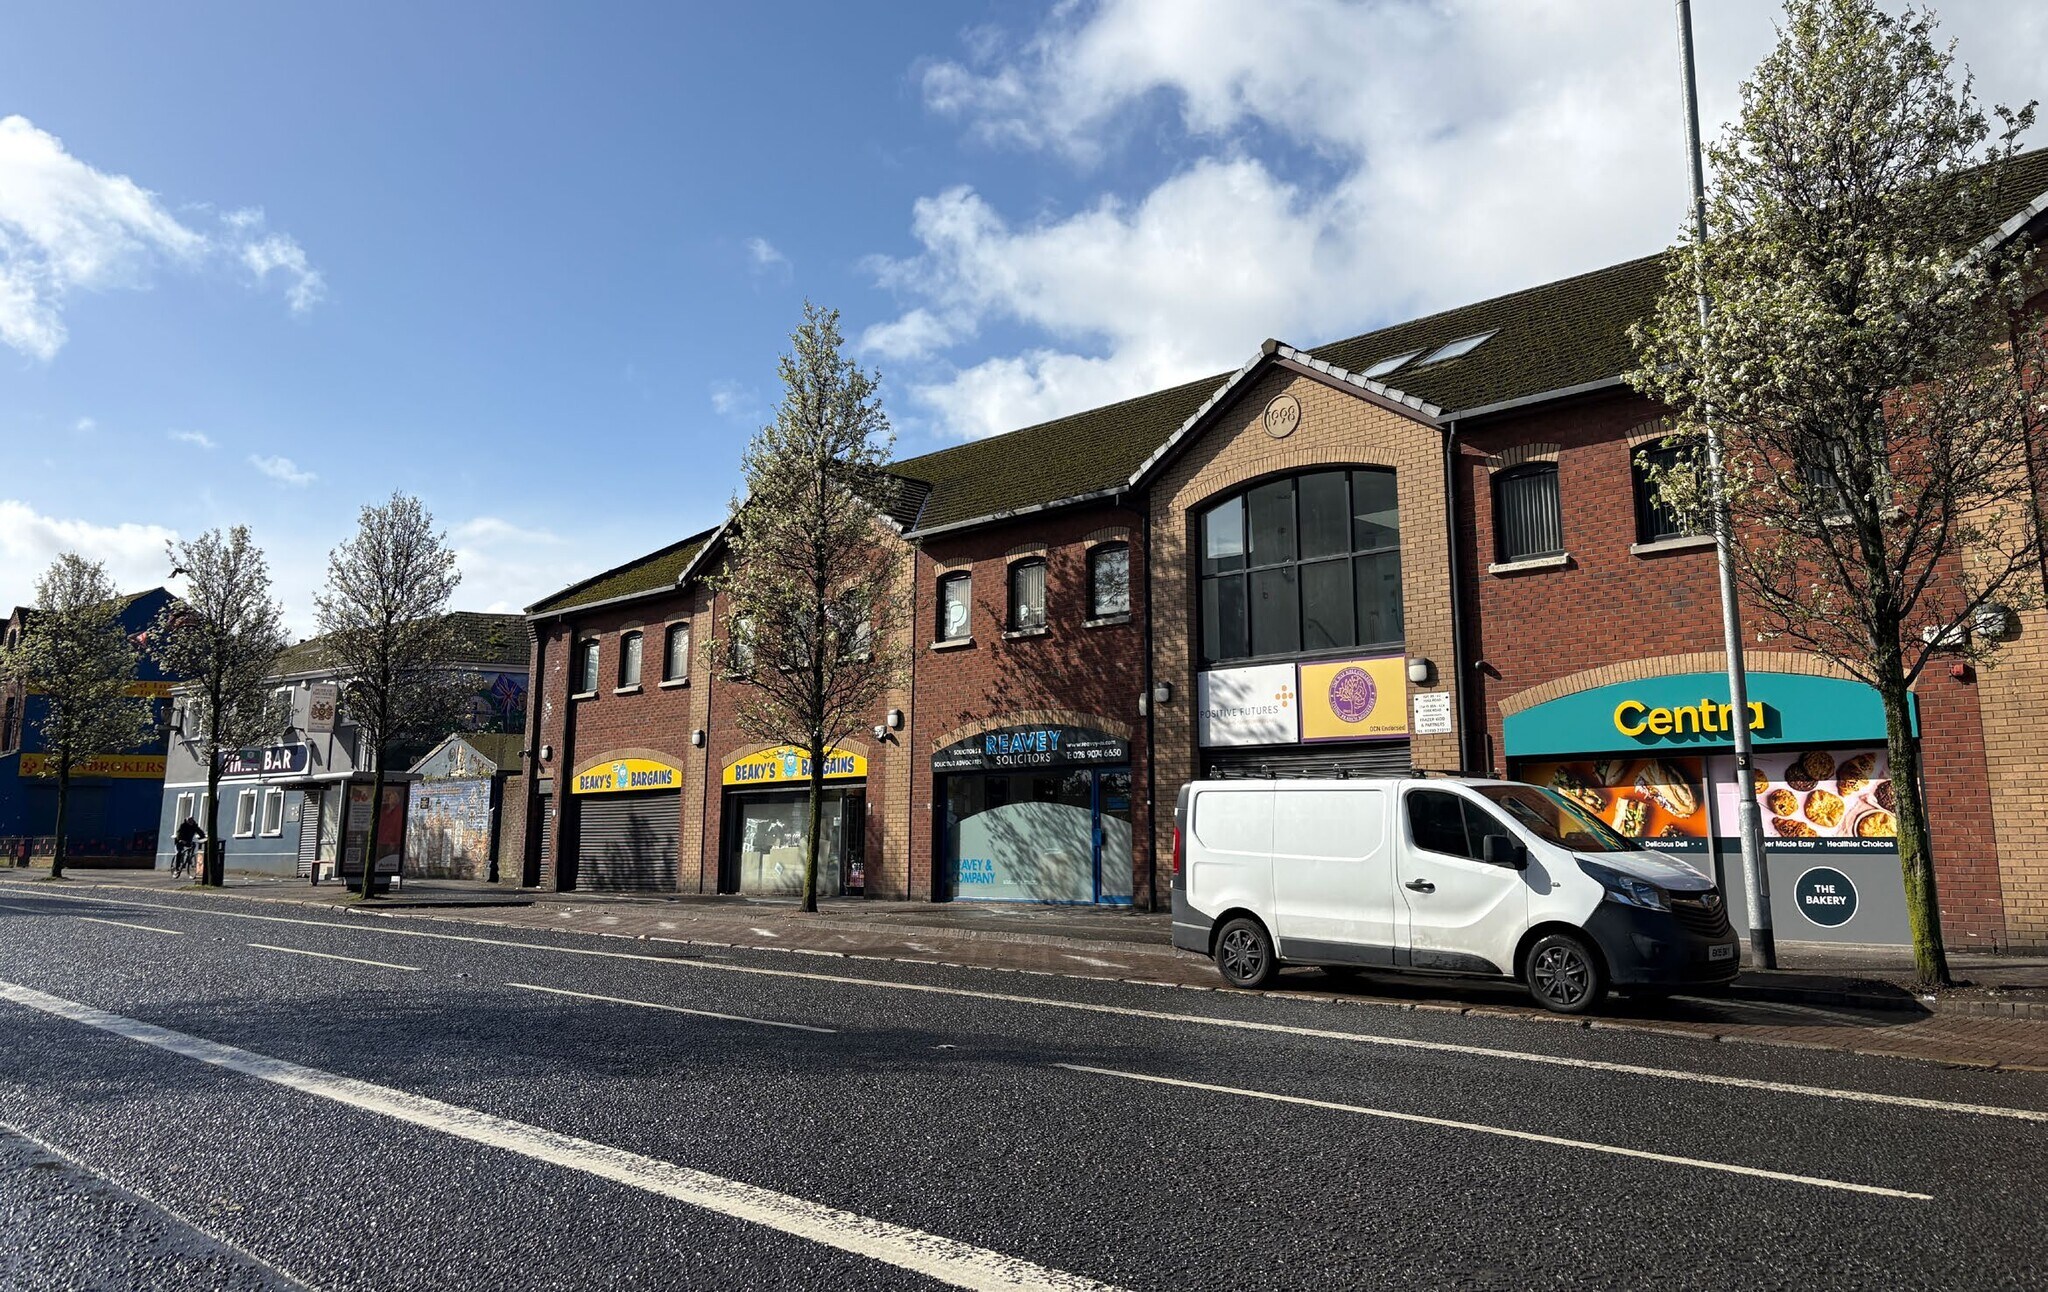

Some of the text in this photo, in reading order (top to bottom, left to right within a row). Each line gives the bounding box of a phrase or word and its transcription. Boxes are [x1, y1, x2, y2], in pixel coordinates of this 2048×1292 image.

[1267, 405, 1296, 427] 1998
[1200, 705, 1279, 719] POSITIVE FUTURES
[1613, 698, 1765, 737] Centra
[985, 730, 1062, 755] REAVEY
[996, 752, 1051, 765] SOLICITORS
[1103, 748, 1122, 757] 6650
[263, 749, 292, 771] BAR
[735, 755, 855, 781] BEAKY'S BAGAINS
[580, 769, 672, 790] BEAKY'S BARGAINS
[1798, 840, 1815, 849] Easy
[1827, 840, 1860, 848] Healthier
[1862, 840, 1893, 848] Choices
[985, 860, 992, 871] &
[1814, 884, 1836, 894] THE
[1805, 895, 1847, 905] BAKERY
